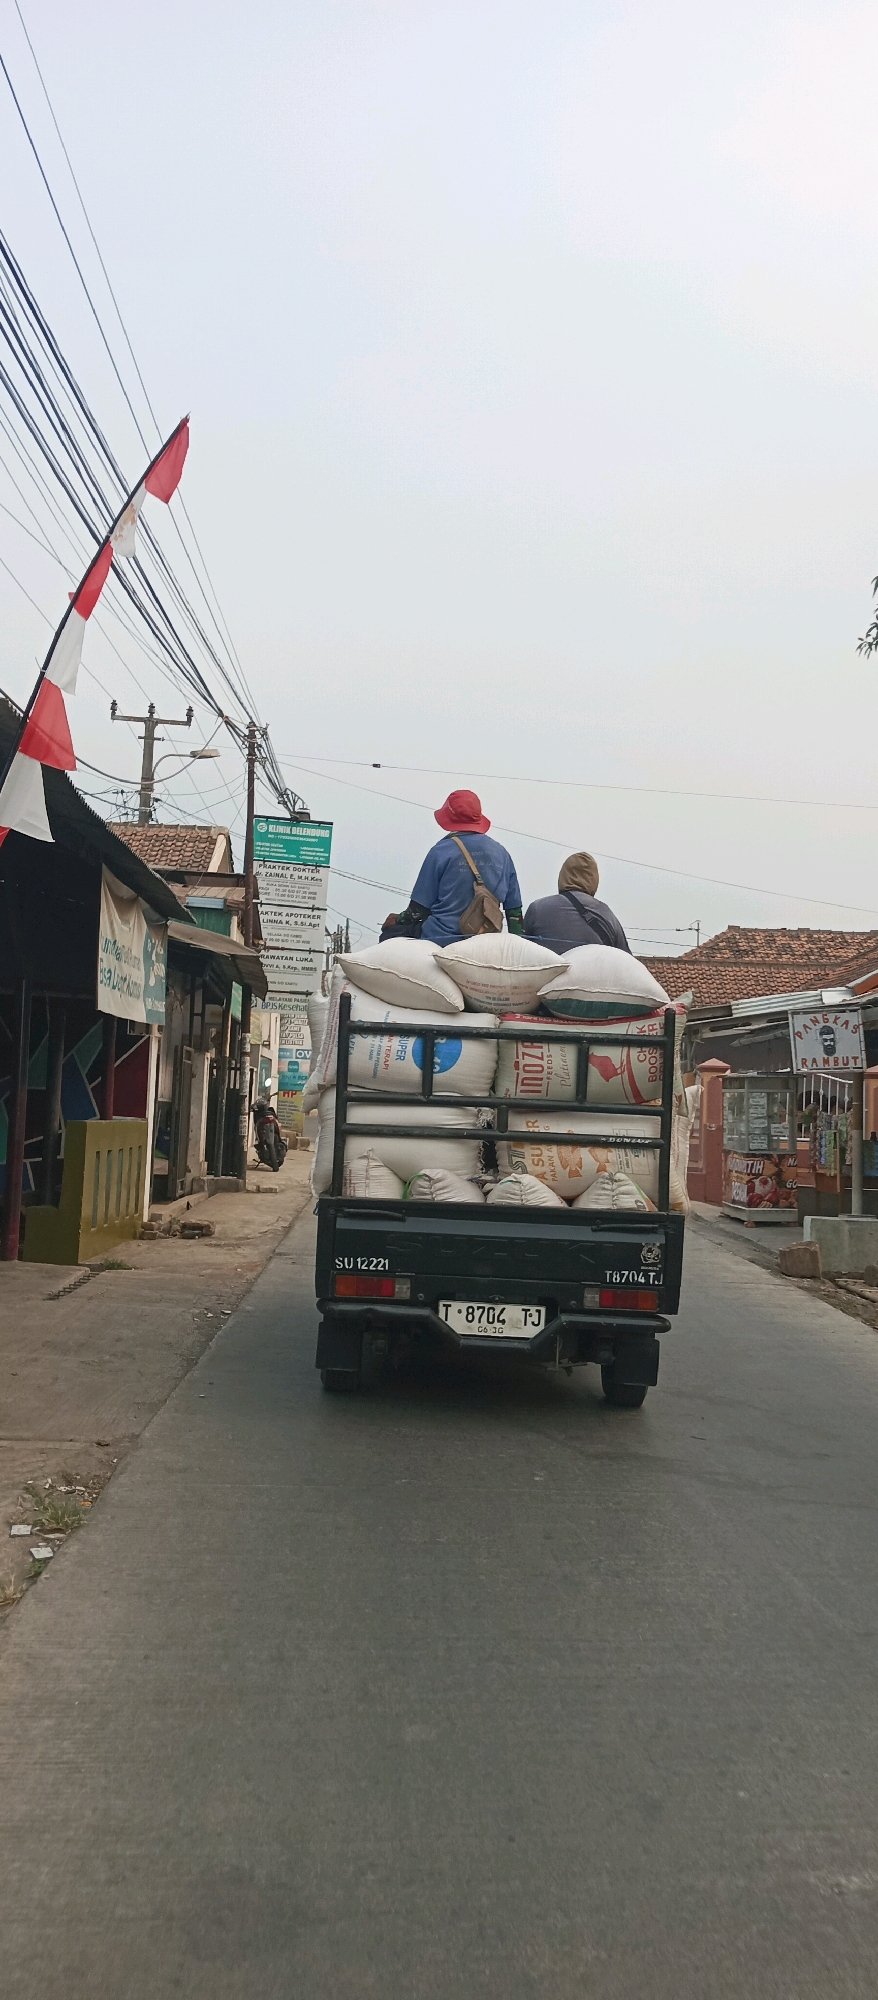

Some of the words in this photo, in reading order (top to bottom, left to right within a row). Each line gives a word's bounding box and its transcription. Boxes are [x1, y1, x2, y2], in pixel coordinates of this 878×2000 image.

[268, 824, 291, 834] KLINIK
[258, 863, 291, 871] PRAKTEK
[292, 866, 320, 874] DOKTER
[264, 871, 288, 879] ZAINAL
[259, 910, 284, 918] AKTEK
[284, 912, 322, 920] APOTEKER
[260, 953, 294, 962] RAWATAN
[261, 1001, 278, 1010] BPJS
[278, 1003, 307, 1012] Kesehat
[795, 1013, 861, 1040] PANGKAS
[394, 1034, 410, 1062] SUPER
[636, 1024, 647, 1063] CHK
[296, 1049, 312, 1059] OV
[382, 1045, 393, 1071] TERAPI
[647, 1022, 658, 1083] BOOSER
[801, 1055, 860, 1069] RAMBUT
[335, 1256, 354, 1270] SU
[356, 1257, 389, 1271] 12221
[604, 1270, 645, 1284] T8704
[442, 1303, 452, 1322] T
[465, 1305, 507, 1326] 8704
[521, 1307, 542, 1327] TJ
